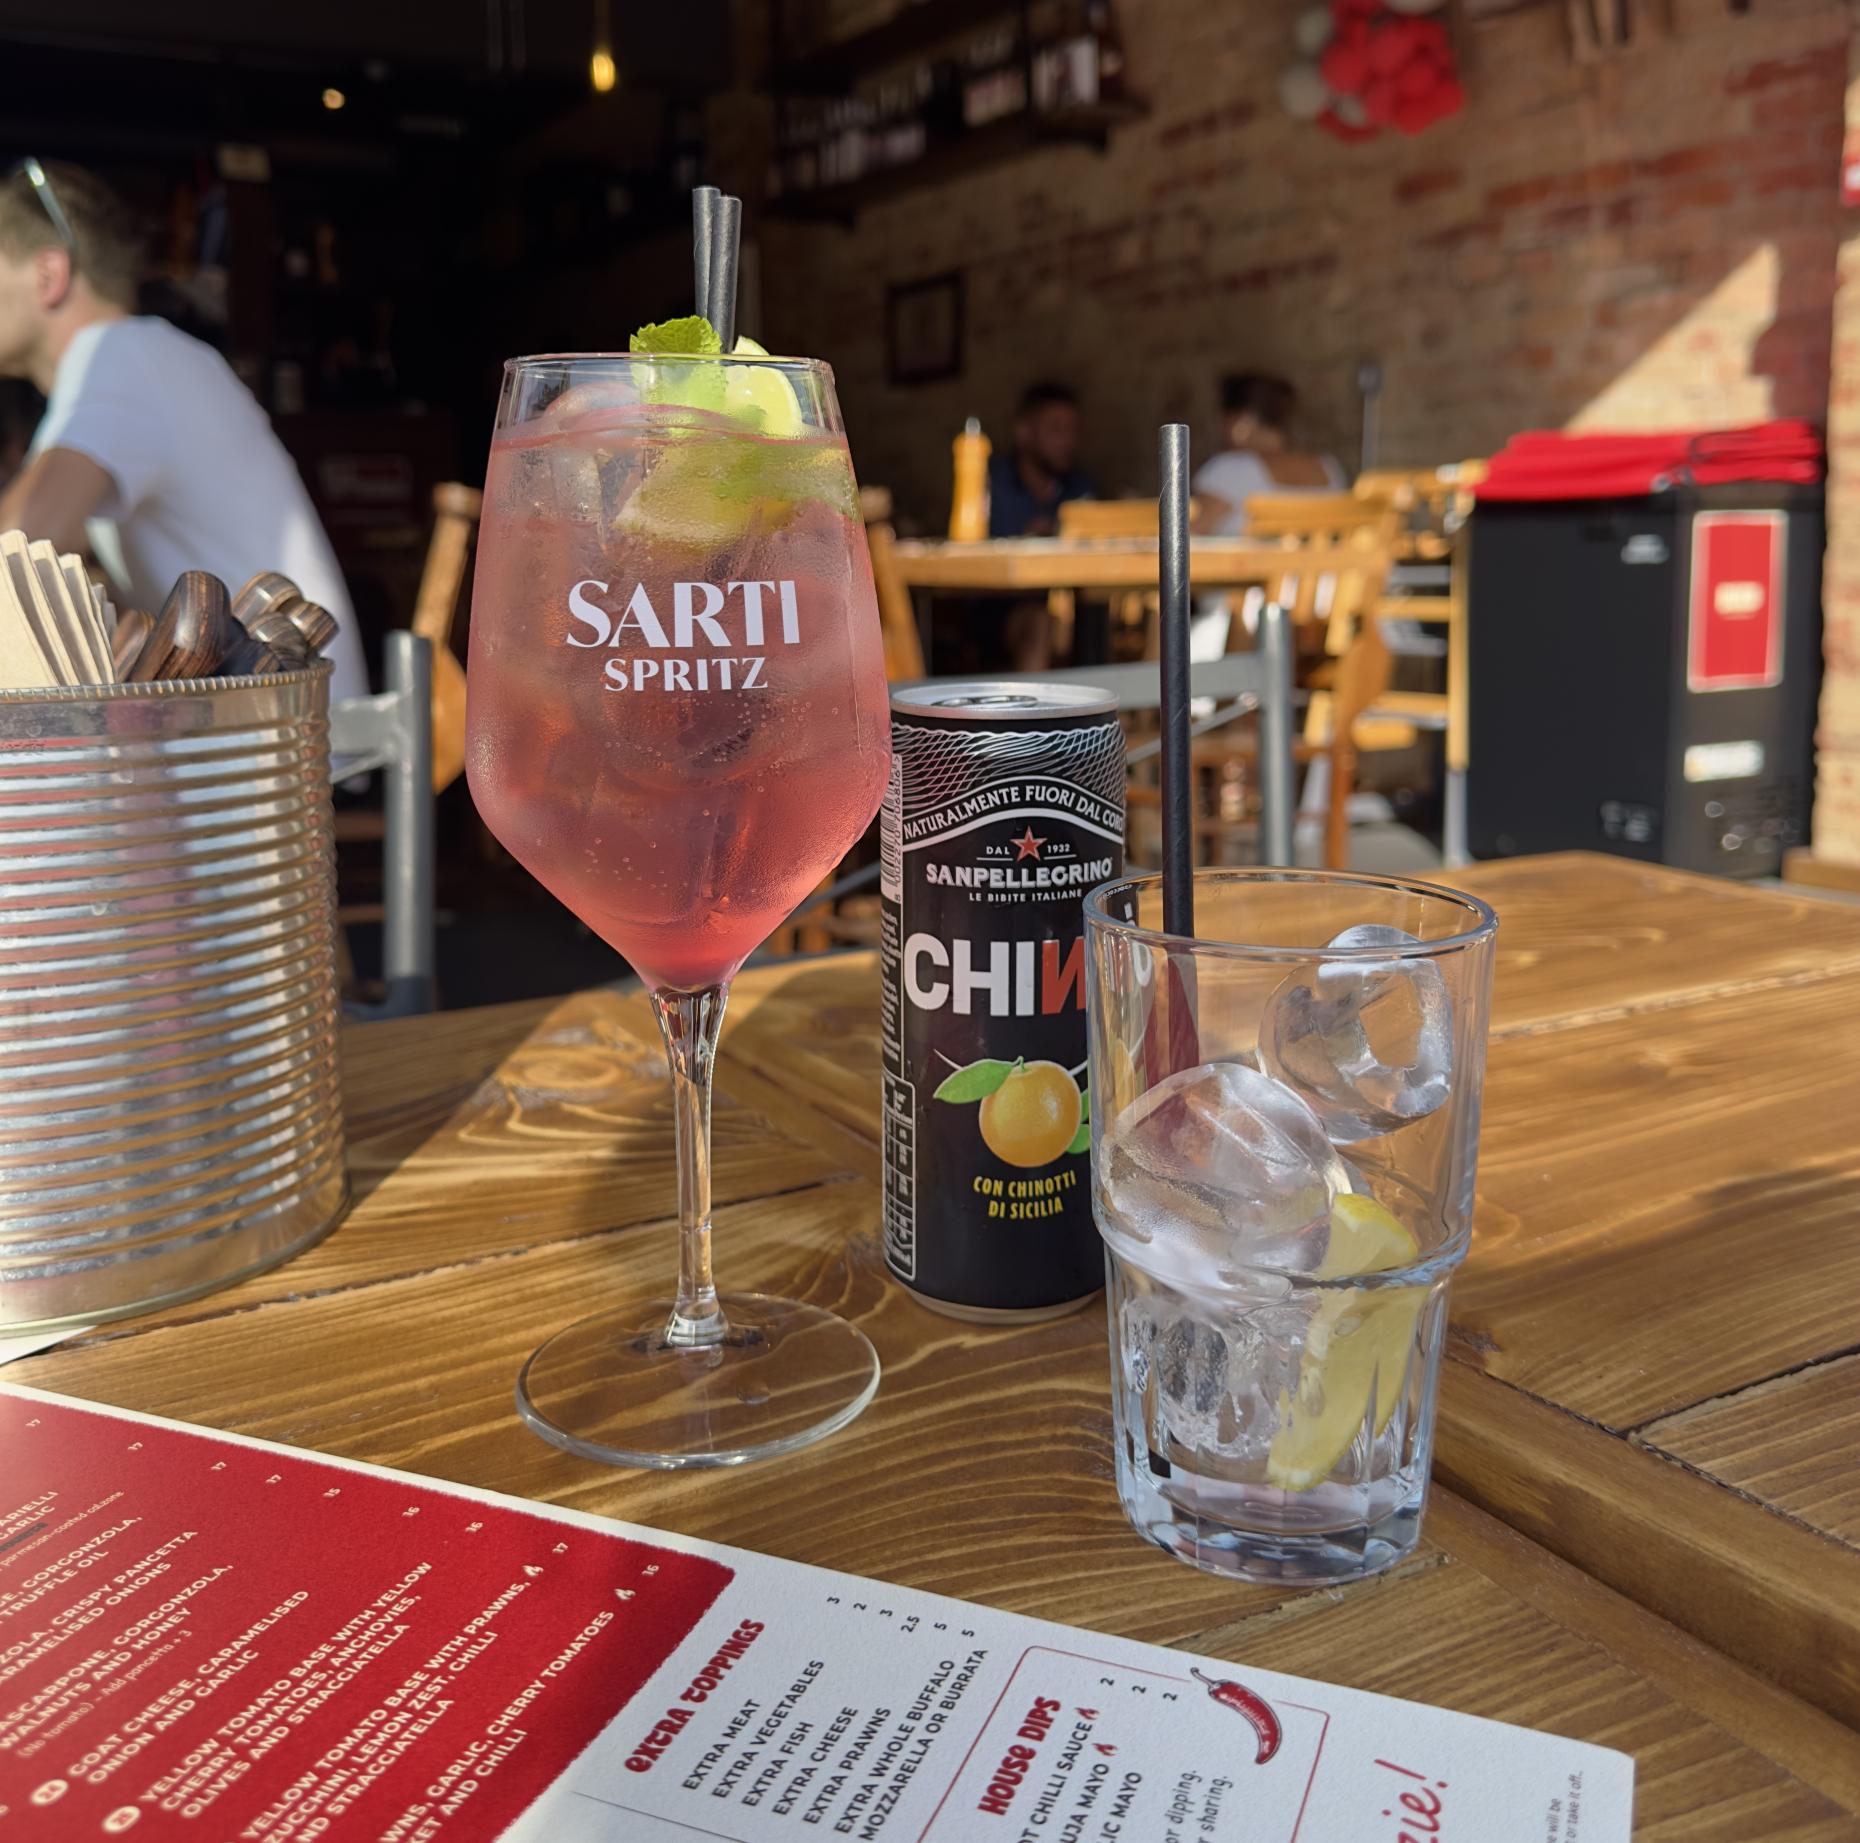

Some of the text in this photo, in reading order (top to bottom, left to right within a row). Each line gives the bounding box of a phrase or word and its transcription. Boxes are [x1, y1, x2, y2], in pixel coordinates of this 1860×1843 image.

[566, 579, 801, 648] SARTI
[604, 656, 769, 692] SPRITZ
[903, 786, 1021, 840] NATURALMENTE
[1025, 784, 1076, 807] FUORI
[1075, 796, 1101, 822] DAL
[926, 857, 1112, 889] SANPELLEGRINO
[986, 843, 1071, 856] DAL 1932
[969, 888, 1082, 903] LE BIBITE ITALIANE
[973, 1169, 1077, 1198] CON CHINOTTI
[988, 1196, 1064, 1220] DI SICILIA
[552, 1542, 568, 1554] 17
[0, 1550, 110, 1617] TRUFFLE OIL
[52, 1583, 113, 1626] CRISPY
[113, 1530, 198, 1584] PANCETTA
[105, 1562, 172, 1606] ONIONS
[827, 1596, 841, 1605] 3
[853, 1602, 867, 1611] 2
[879, 1608, 893, 1617] 3
[900, 1615, 921, 1633] 2.5
[934, 1622, 948, 1631] 5
[961, 1629, 975, 1638] 5
[0, 1607, 192, 1749] WALNUTS AND HONEY
[121, 1677, 202, 1734] CHEESE,
[198, 1590, 309, 1676] CARAMELISED
[125, 1643, 175, 1682] pancetta
[138, 1561, 432, 1802] YELLOW TOMATO BASE WITH YELLOW
[1100, 1677, 1115, 1687] 2
[1131, 1684, 1147, 1694] 2
[160, 1595, 422, 1812] CHERRY TOMATOES, ANCHOVIES,
[179, 1623, 411, 1818] OLIVES AND STRACCIATELLA
[239, 1580, 532, 1838] YELLOW TOMATO BASE WITH PRAWNS,
[351, 1711, 414, 1763] LEMON
[407, 1672, 456, 1711] ZEST,
[449, 1631, 498, 1673] CHILLI
[426, 1739, 496, 1797] GARLIC,
[486, 1679, 547, 1736] CHERRY
[540, 1610, 614, 1679] TOMATOES
[1016, 1696, 1062, 1743] DIPS
[1162, 1692, 1178, 1702] 2
[87, 1732, 156, 1784] ONION
[154, 1699, 197, 1733] AND
[325, 1699, 455, 1814] STRACCIATELLA
[682, 1698, 762, 1791] EXTRA MEAT
[711, 1660, 825, 1799] EXTRA VEGETABLES
[833, 1659, 956, 1835] EXTRA WHOLE BUFFALO
[858, 1649, 988, 1842] MOZZARELLA OR BURRATA
[439, 1779, 479, 1816] AND
[474, 1728, 528, 1777] CHILLI
[741, 1721, 815, 1807] EXTRA FISH
[772, 1706, 860, 1816] EXTRA CHEESE
[802, 1707, 892, 1825] EXTRA PRAWNS
[1030, 1773, 1068, 1825] CHILLI
[1056, 1720, 1093, 1772] SAUCE
[1075, 1763, 1110, 1809] MAYO
[1109, 1771, 1143, 1819] MAYO
[1164, 1770, 1203, 1824] dipping.
[1196, 1776, 1234, 1832] sharing.
